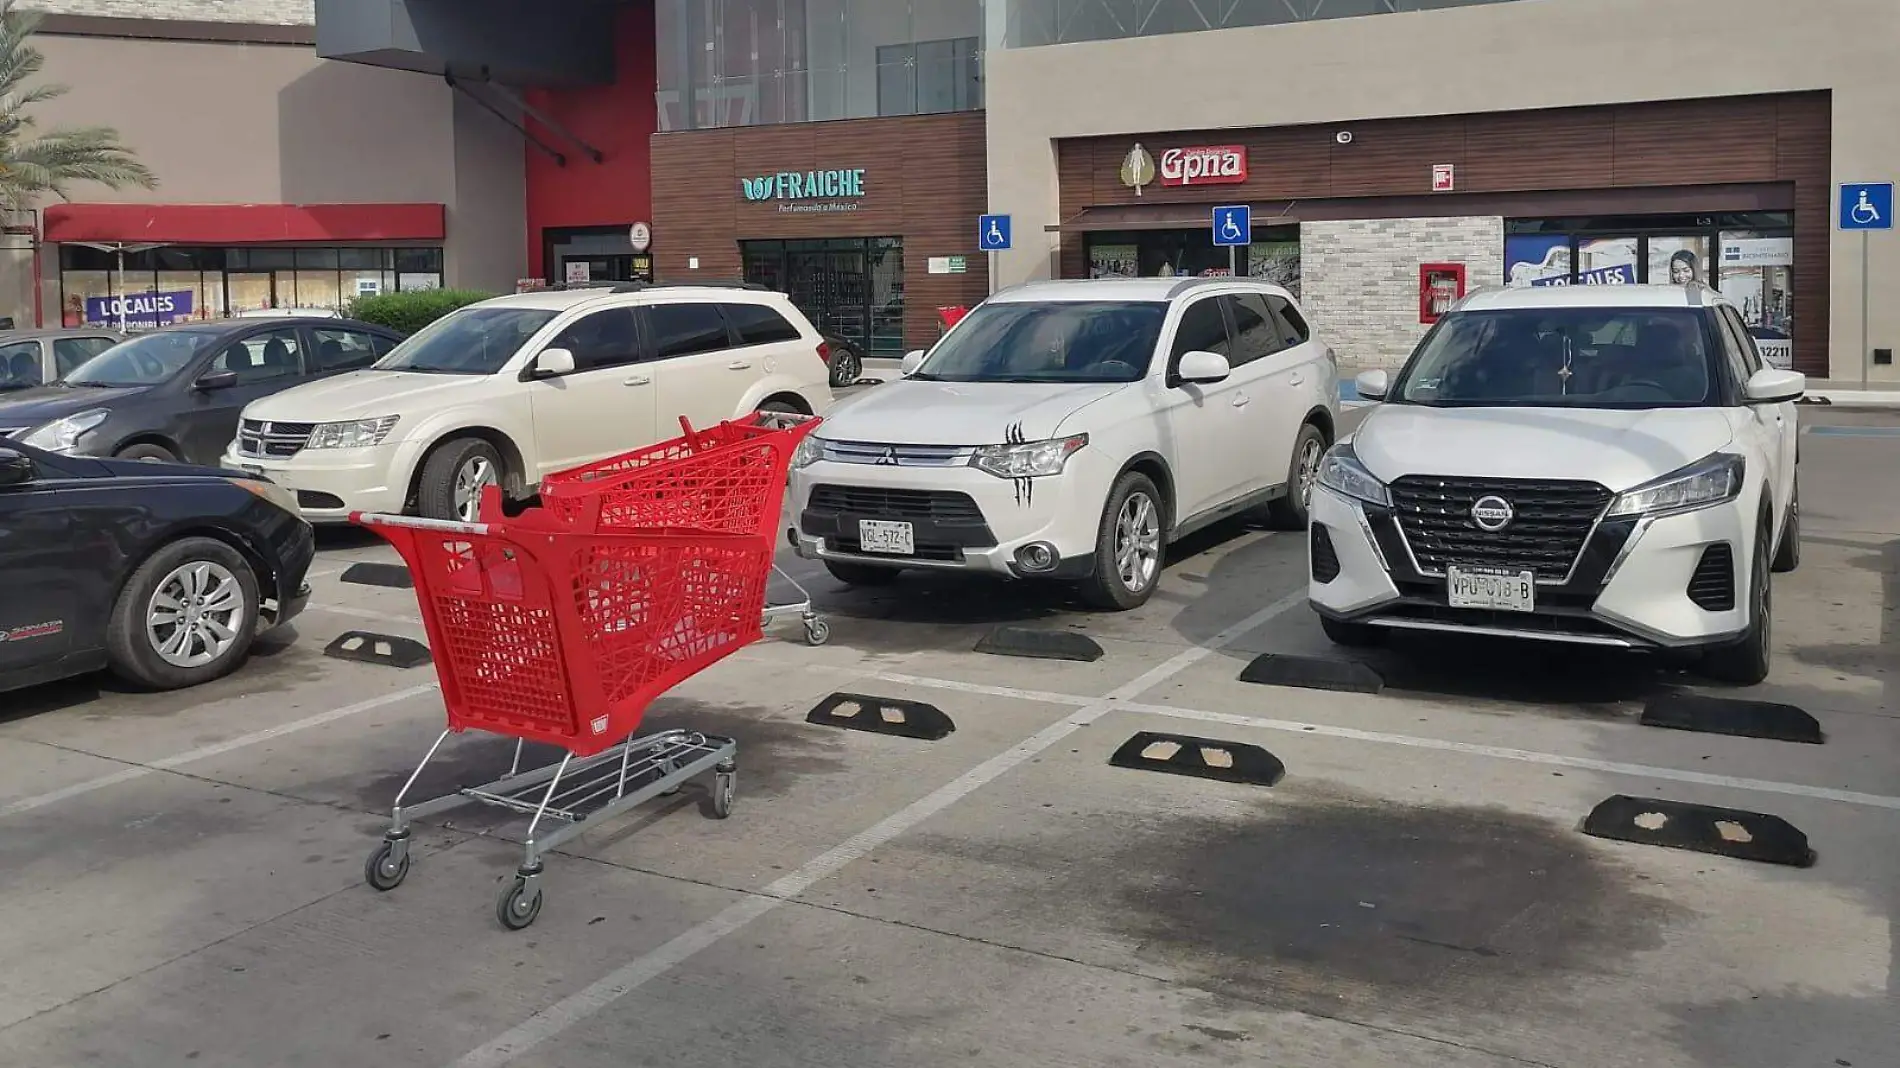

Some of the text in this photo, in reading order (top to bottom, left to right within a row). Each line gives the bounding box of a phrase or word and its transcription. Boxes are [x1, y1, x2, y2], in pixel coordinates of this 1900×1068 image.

[1161, 148, 1243, 185] Gpna
[776, 169, 865, 199] FRAICHE
[100, 296, 174, 316] LOCALES
